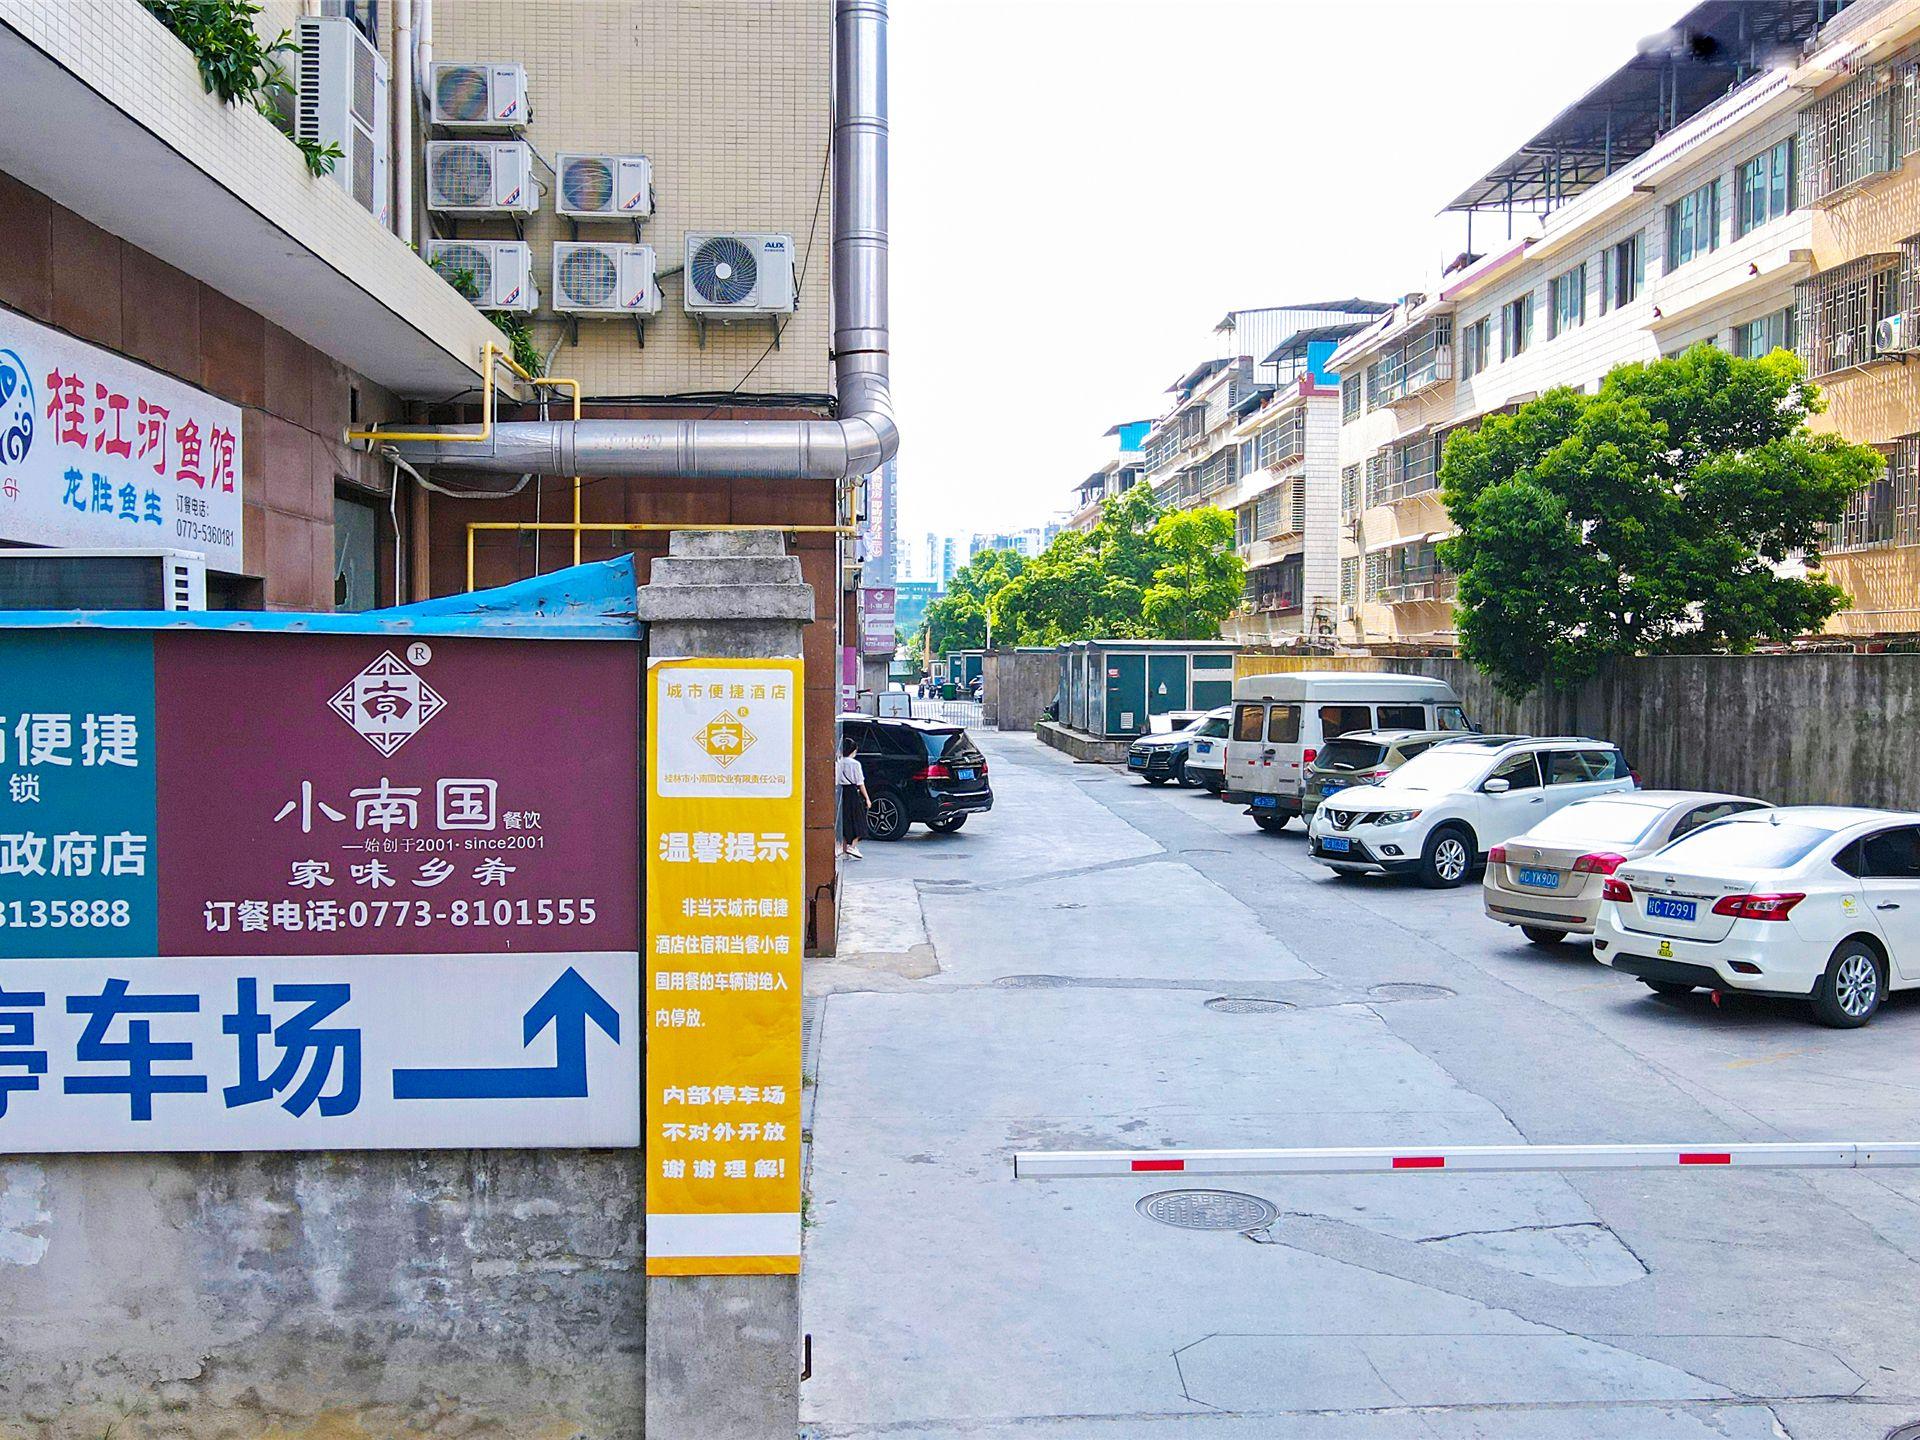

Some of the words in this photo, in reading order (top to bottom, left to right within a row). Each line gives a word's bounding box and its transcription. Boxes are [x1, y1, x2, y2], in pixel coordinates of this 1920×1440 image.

[765, 241, 785, 249] AUX
[46, 367, 236, 493] 桂江河鱼馆
[62, 465, 164, 526] 龙胜鱼生
[176, 518, 234, 547] 0773-5360181
[667, 683, 786, 700] 城市便捷酒店
[0, 713, 138, 767] 便捷
[9, 773, 41, 803] 锁
[274, 777, 498, 834] 小南国
[502, 810, 542, 830] 餐饮
[0, 830, 147, 877] 政府店
[464, 835, 545, 850] since2001
[659, 831, 790, 864] 温馨提示
[287, 856, 517, 889] 家味乡肴
[682, 898, 789, 918] 非当天城市便捷
[655, 935, 790, 955] 酒店住宿和当餐小南
[655, 971, 788, 992] 国用餐的车辆谢绝入
[663, 1085, 786, 1106] 内部停车场
[661, 1122, 786, 1142] 不对外开放
